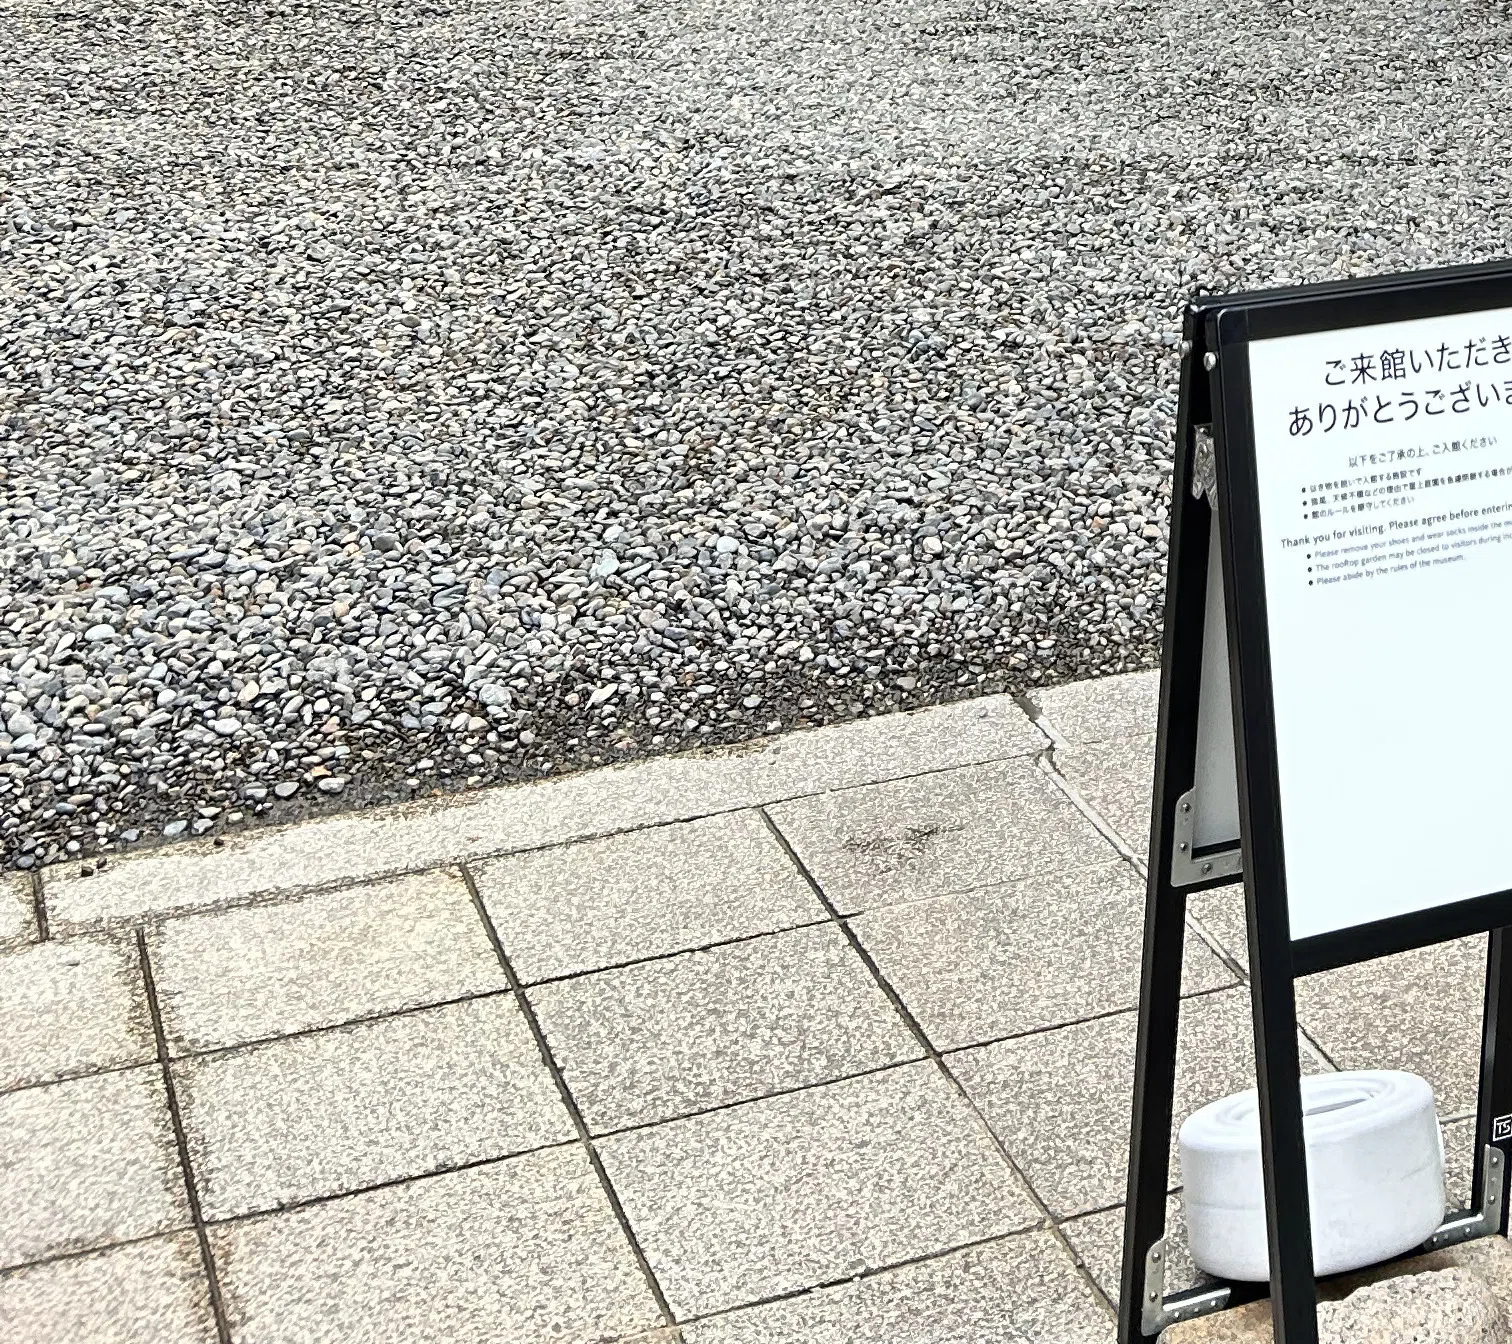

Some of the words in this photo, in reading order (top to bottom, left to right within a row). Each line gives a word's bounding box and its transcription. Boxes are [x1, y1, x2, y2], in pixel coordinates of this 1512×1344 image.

[1323, 333, 1512, 386] ご来館いただき
[1281, 535, 1310, 549] Thank
[1312, 533, 1330, 545] you
[1332, 530, 1347, 540] for
[1389, 518, 1419, 531] Please
[1421, 514, 1448, 527] agree
[1449, 508, 1479, 521] before
[1316, 564, 1330, 572] The
